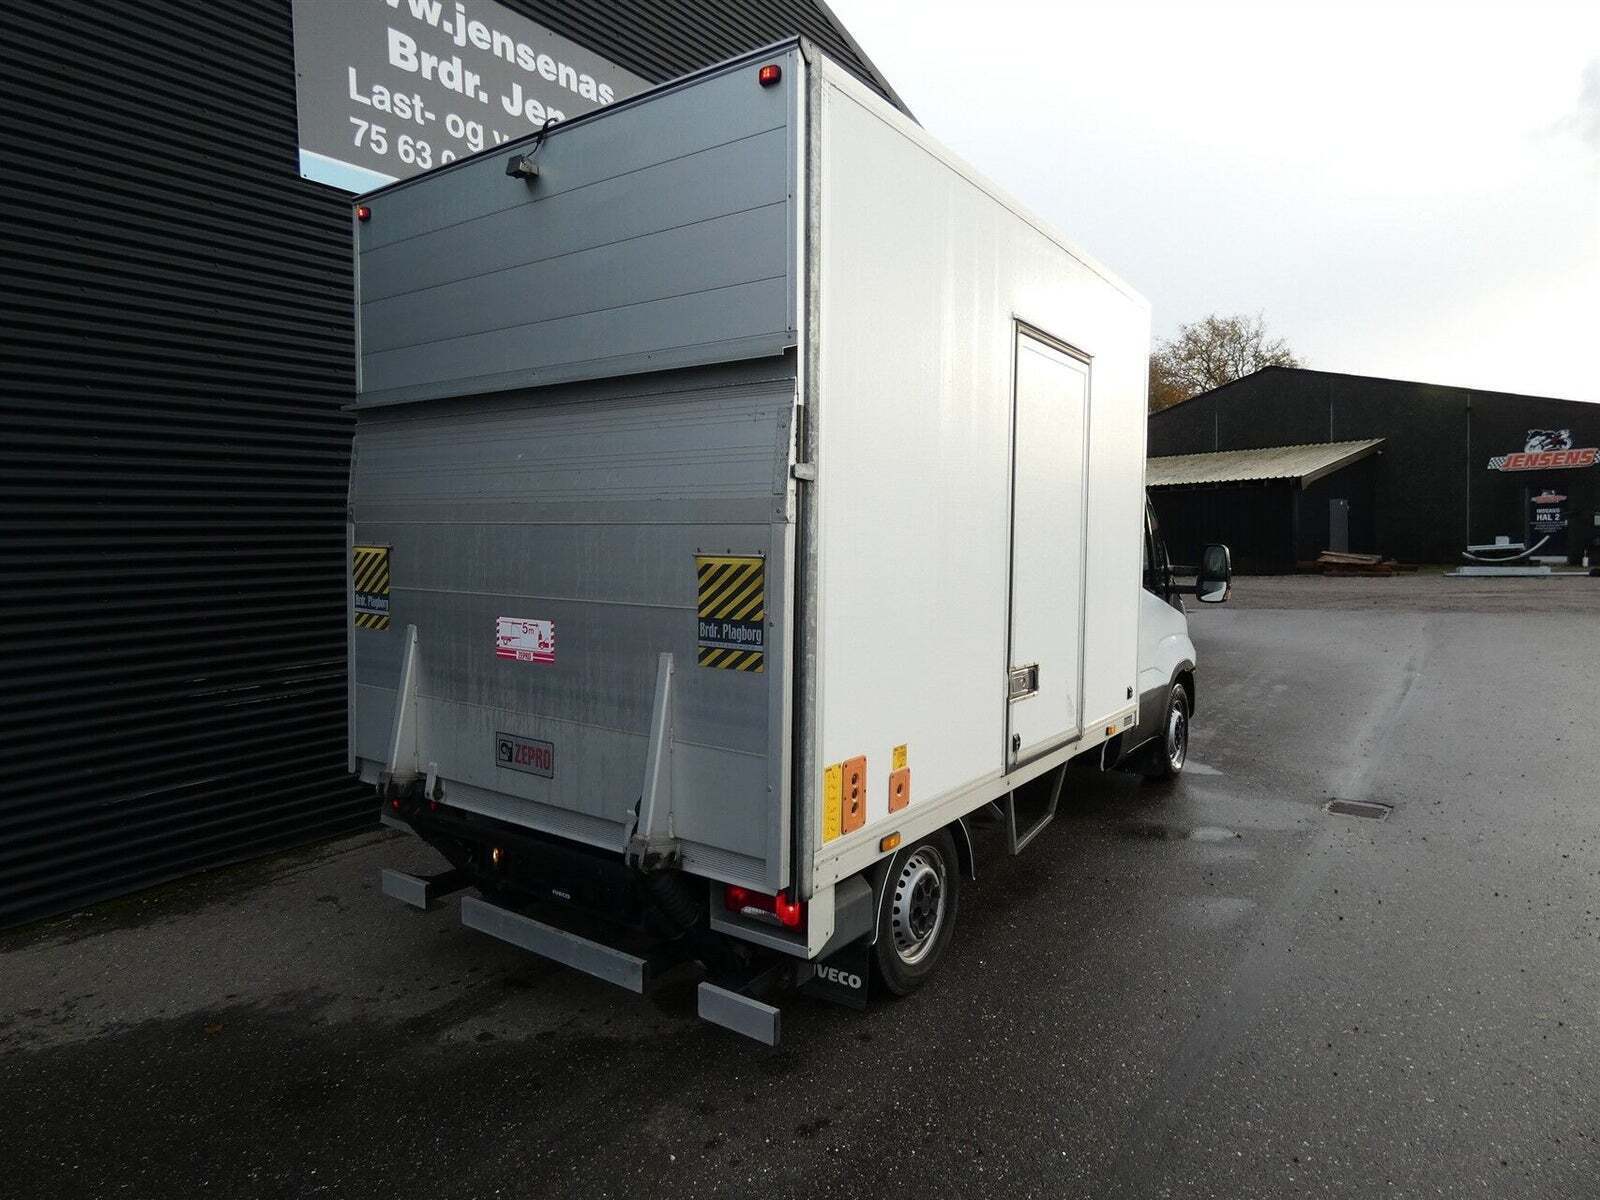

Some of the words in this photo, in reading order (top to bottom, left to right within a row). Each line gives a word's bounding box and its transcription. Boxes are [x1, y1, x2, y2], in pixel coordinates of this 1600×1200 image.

[387, 27, 488, 104] Brdr.
[348, 66, 435, 125] Last-
[445, 113, 484, 153] og
[350, 116, 388, 155] 75
[398, 134, 432, 169] 63
[1503, 450, 1594, 468] JENSENS
[699, 622, 720, 639] Brdr.
[723, 624, 763, 645] Plagborg
[515, 743, 551, 770] ZEPRO
